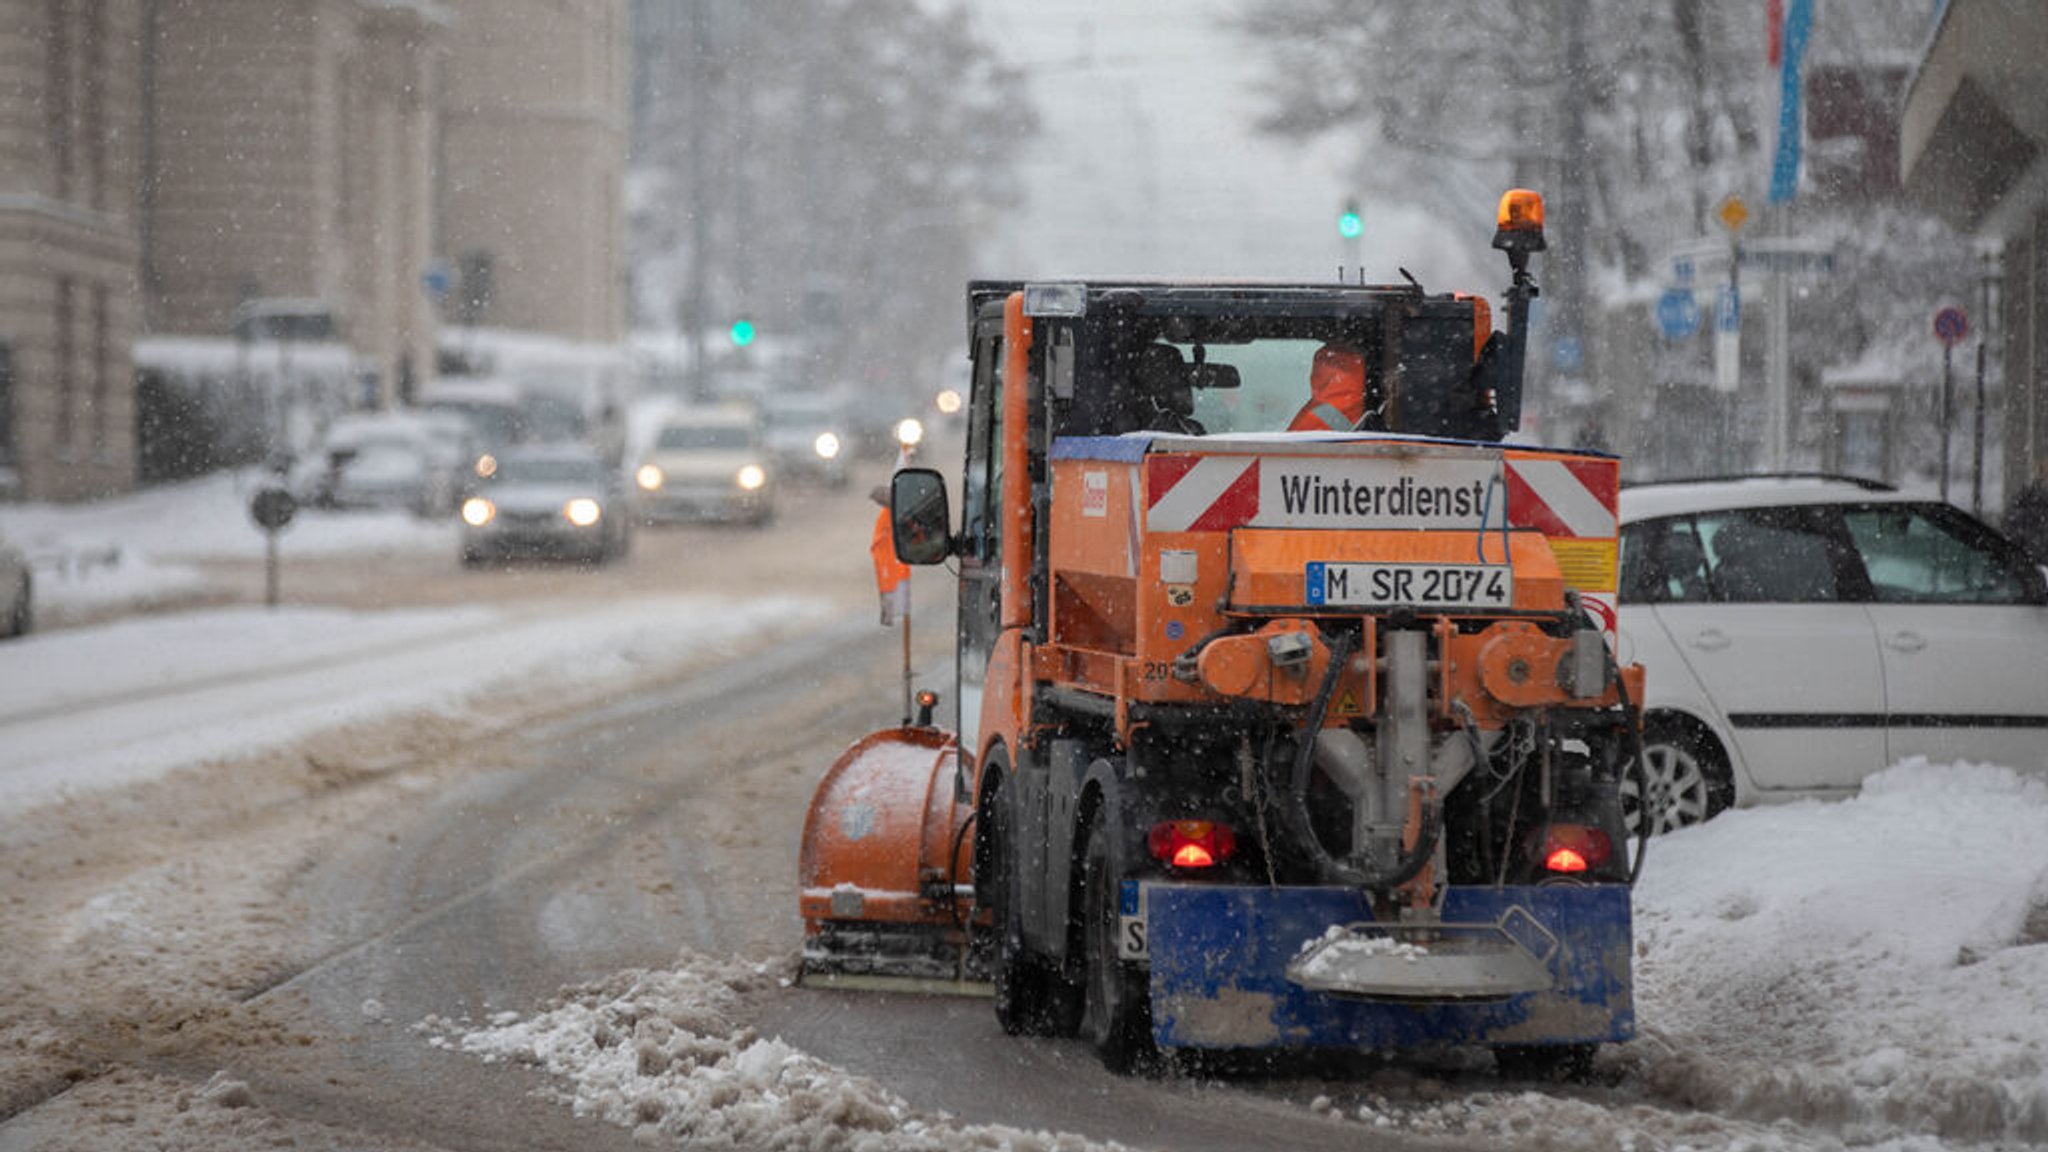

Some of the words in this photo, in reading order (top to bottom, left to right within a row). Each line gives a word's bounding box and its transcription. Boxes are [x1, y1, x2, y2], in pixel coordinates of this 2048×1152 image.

[1281, 475, 1483, 516] Winterdienst
[1328, 568, 1347, 600] M
[1371, 569, 1413, 601] SR
[1422, 570, 1505, 602] 2074
